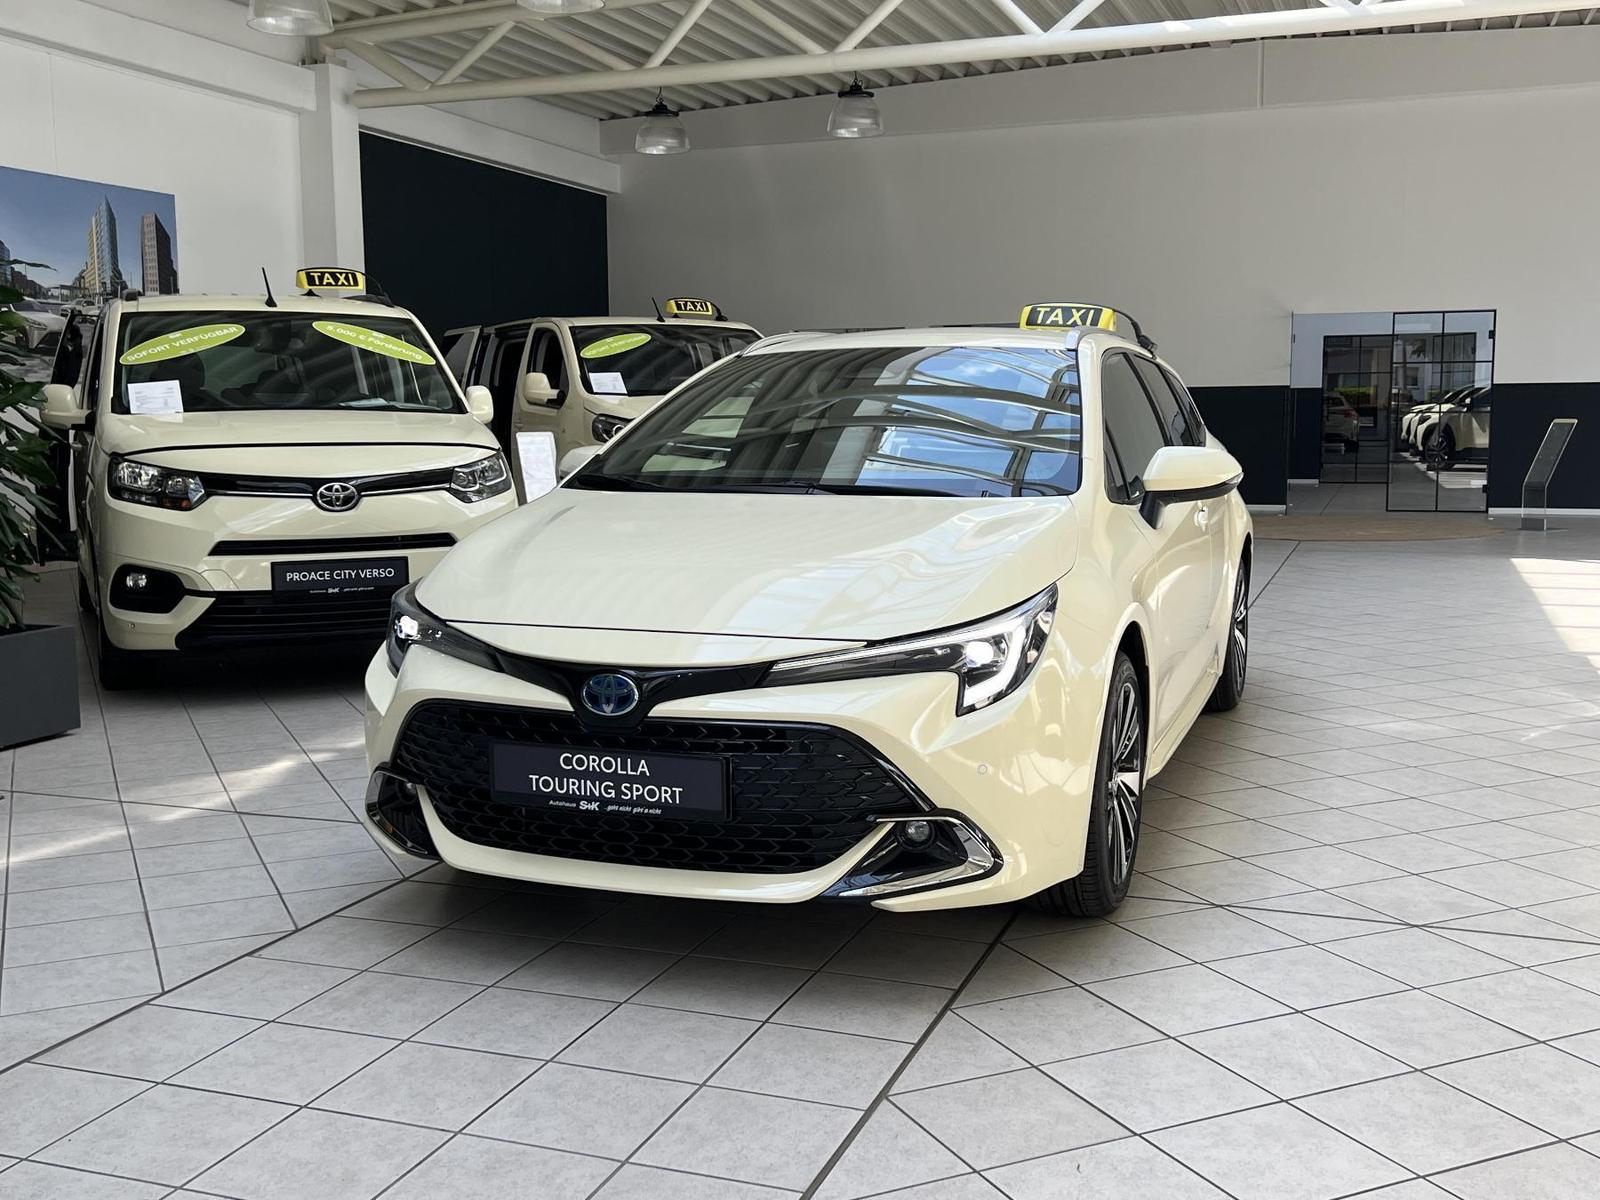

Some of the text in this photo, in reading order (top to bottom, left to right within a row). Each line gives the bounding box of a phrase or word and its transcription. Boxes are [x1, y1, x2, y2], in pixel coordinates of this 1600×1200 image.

[309, 272, 354, 286] TAXI
[677, 301, 707, 311] TAXI
[1036, 307, 1095, 326] TAXI
[126, 344, 171, 361] SOFORT
[286, 568, 395, 581] PROACE CITY VERSO
[559, 753, 650, 776] COROLLA
[529, 774, 683, 804] TOURING SPORT
[548, 800, 577, 808] Autohaus
